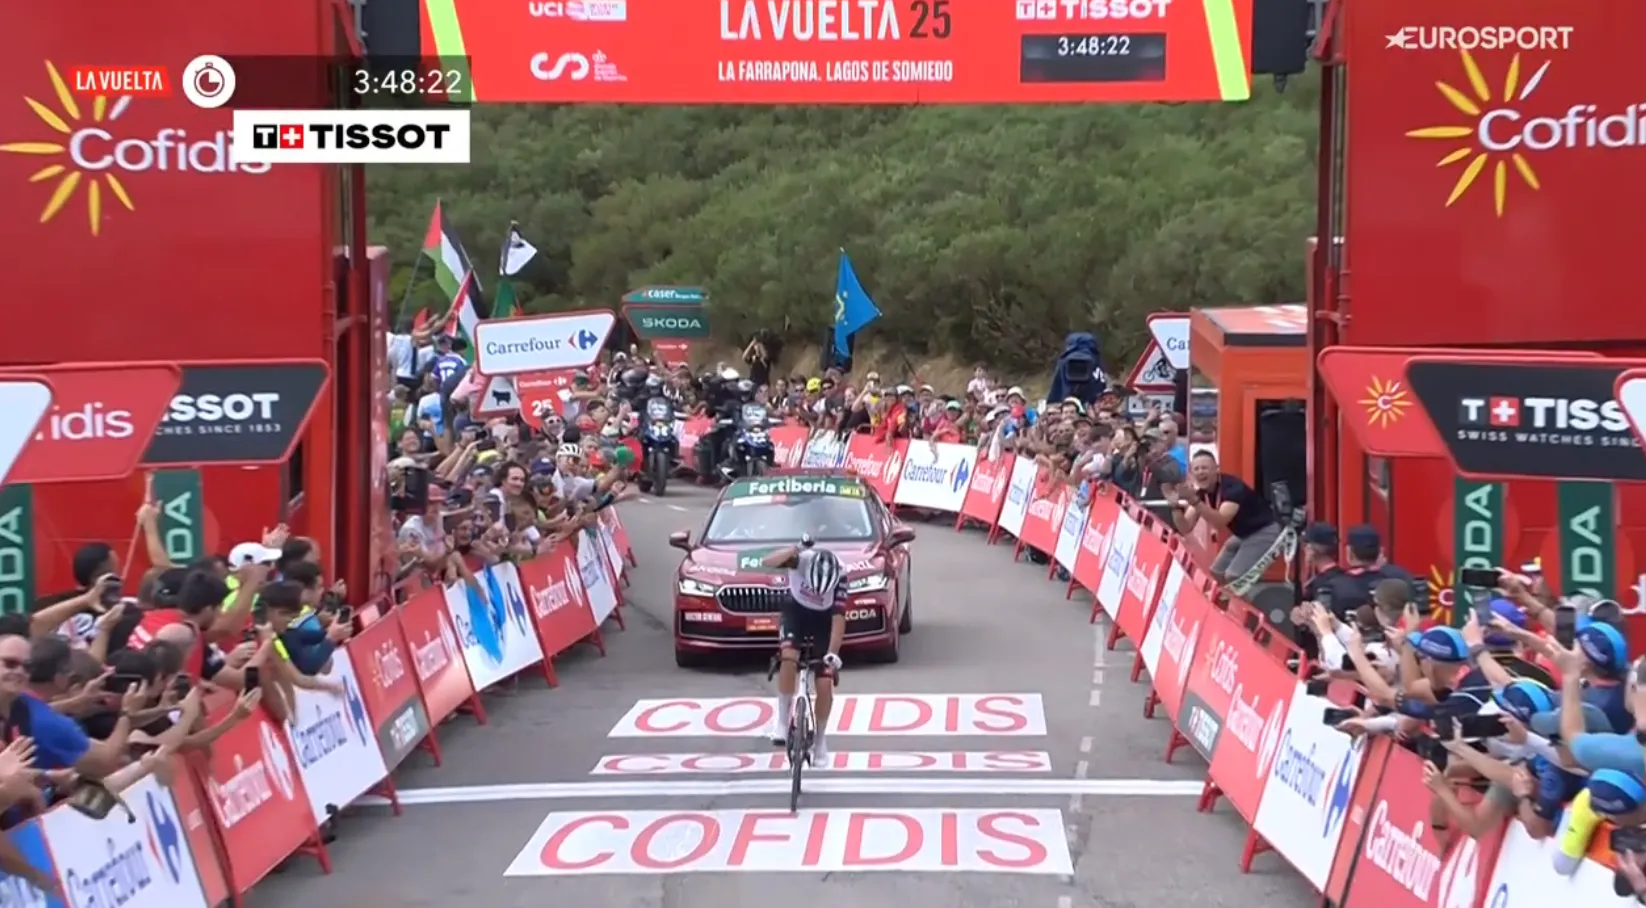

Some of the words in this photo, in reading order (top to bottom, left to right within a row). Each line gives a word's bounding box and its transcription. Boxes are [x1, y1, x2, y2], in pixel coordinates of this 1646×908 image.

[528, 1, 564, 17] UCI
[720, 0, 761, 40] LA
[771, 0, 900, 40] VUELTA
[909, 0, 952, 39] 25
[1065, 0, 1171, 20] TISSOT
[1058, 36, 1130, 56] 3:48:22
[718, 61, 735, 81] LA
[738, 61, 822, 82] FARRAPONA.
[826, 61, 870, 81] LAGOS
[872, 61, 889, 81] DE
[892, 60, 953, 81] SOMIEDO
[1478, 104, 1646, 150] Cofidi
[485, 335, 562, 355] Carrefour
[35, 402, 134, 440] idis
[161, 393, 280, 422] SSOT
[1524, 397, 1632, 432] TISS
[1457, 429, 1508, 442] SWISS
[1514, 432, 1594, 446] WATCHES
[1600, 436, 1642, 448] SINC
[903, 457, 949, 485] Carrefour
[748, 478, 837, 495] Fertiberia
[634, 697, 1031, 733] COIDIS
[539, 812, 1049, 870] COFIDIS
[1366, 800, 1441, 903] Carrefour
